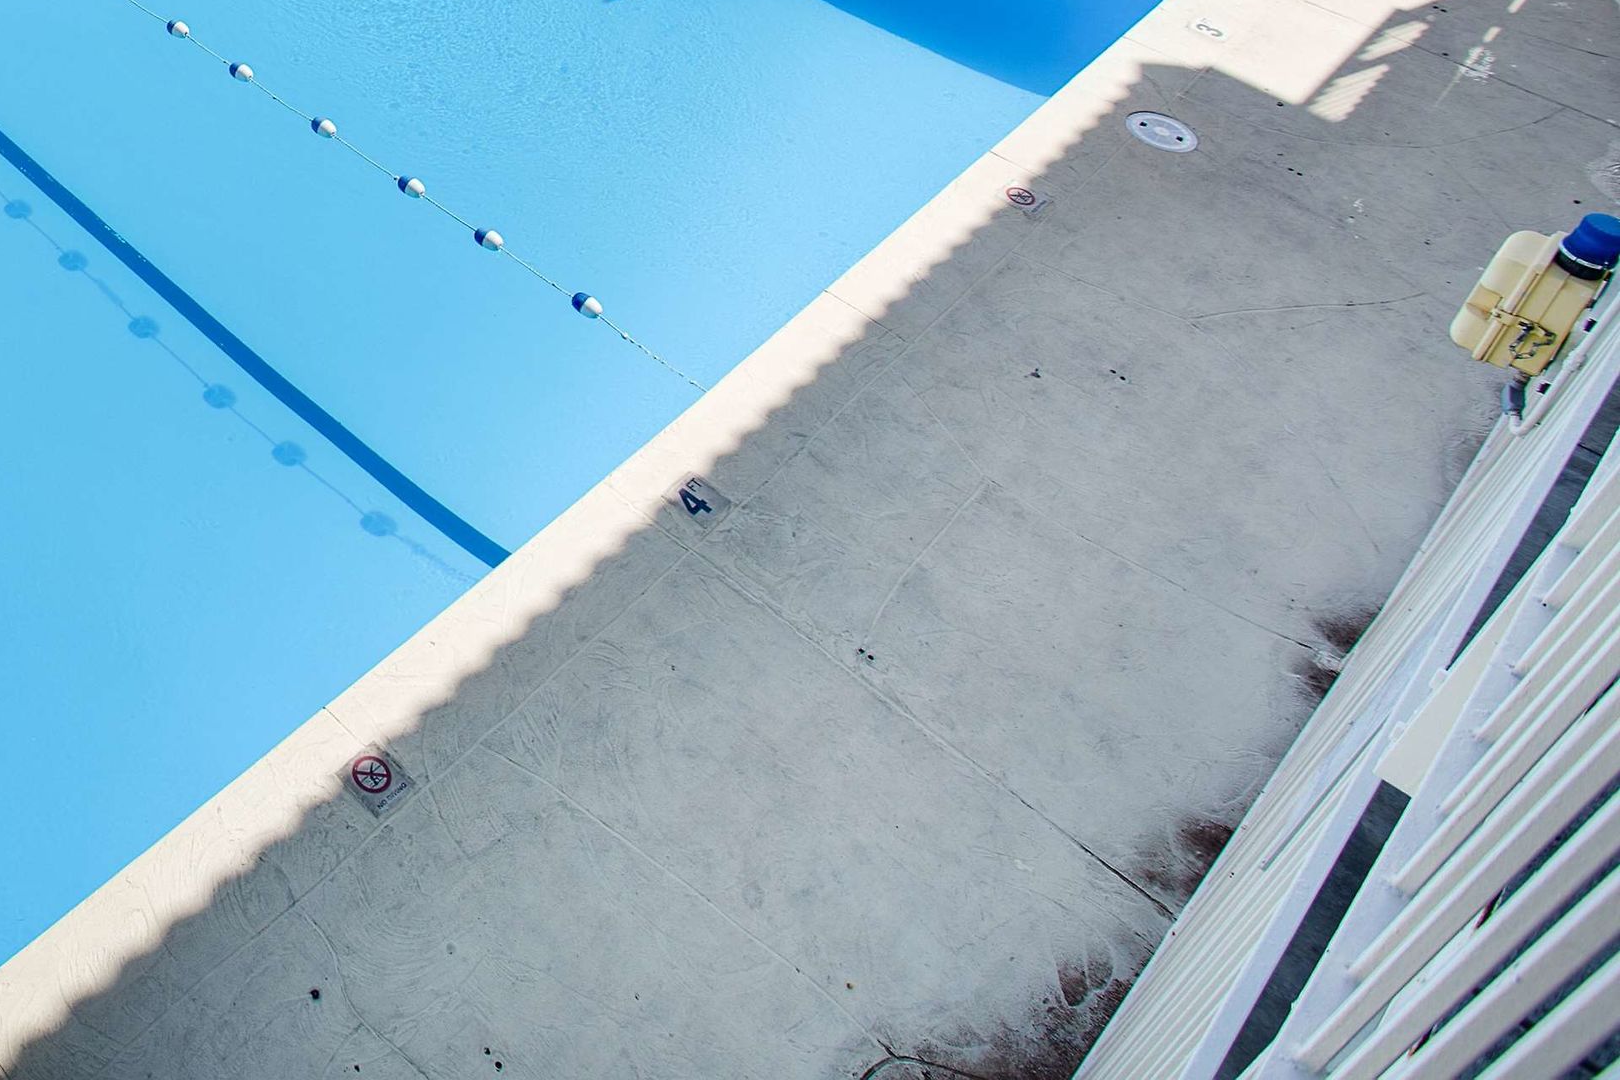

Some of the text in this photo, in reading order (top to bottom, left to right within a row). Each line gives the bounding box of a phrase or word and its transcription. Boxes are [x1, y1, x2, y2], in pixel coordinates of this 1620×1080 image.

[678, 477, 713, 516] 4 FT
[377, 798, 388, 810] NO
